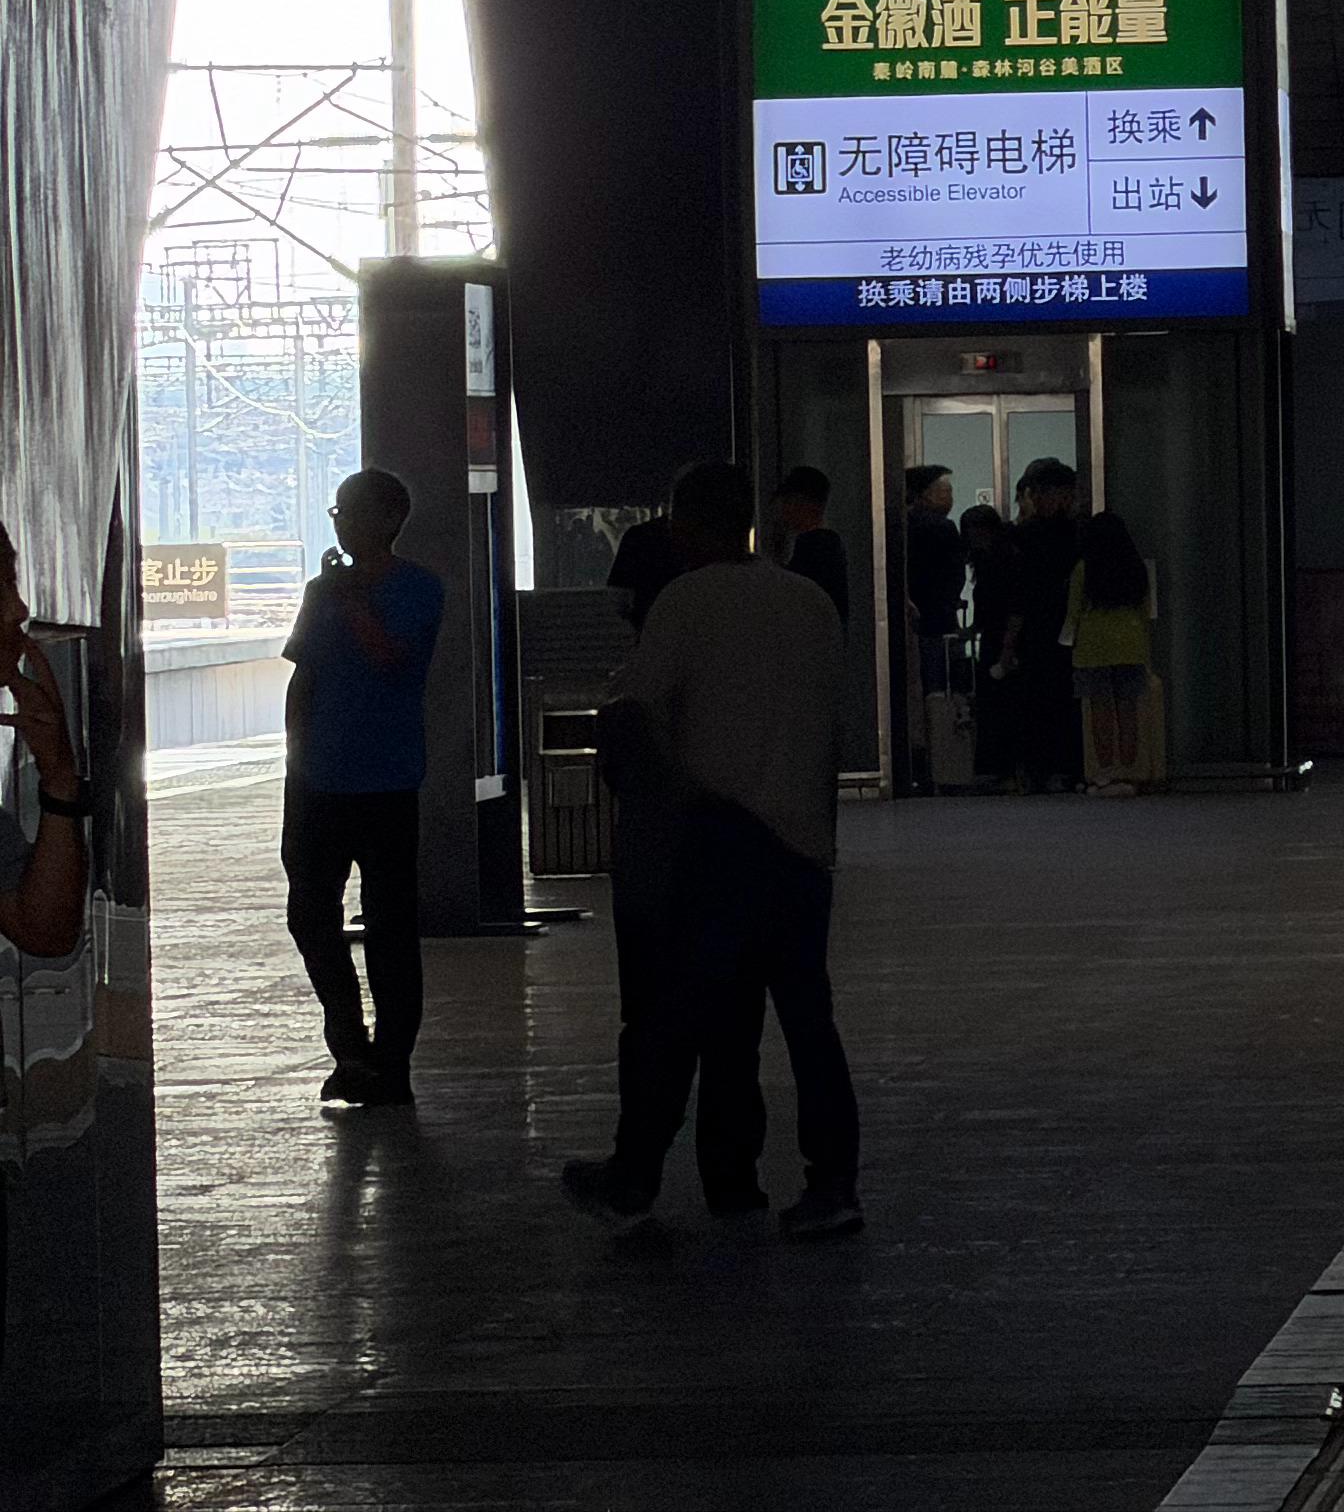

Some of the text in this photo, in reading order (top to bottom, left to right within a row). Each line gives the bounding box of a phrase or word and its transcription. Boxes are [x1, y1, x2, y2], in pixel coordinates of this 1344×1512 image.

[1108, 108, 1182, 145] 换乘
[838, 128, 1077, 178] 无障碍电梯
[838, 181, 1026, 204] Accessible Elevator
[1111, 176, 1184, 212] 出站
[880, 241, 1126, 272] 老幼病残孕优先使用
[858, 274, 1147, 308] 换乘请由两侧步梯上楼
